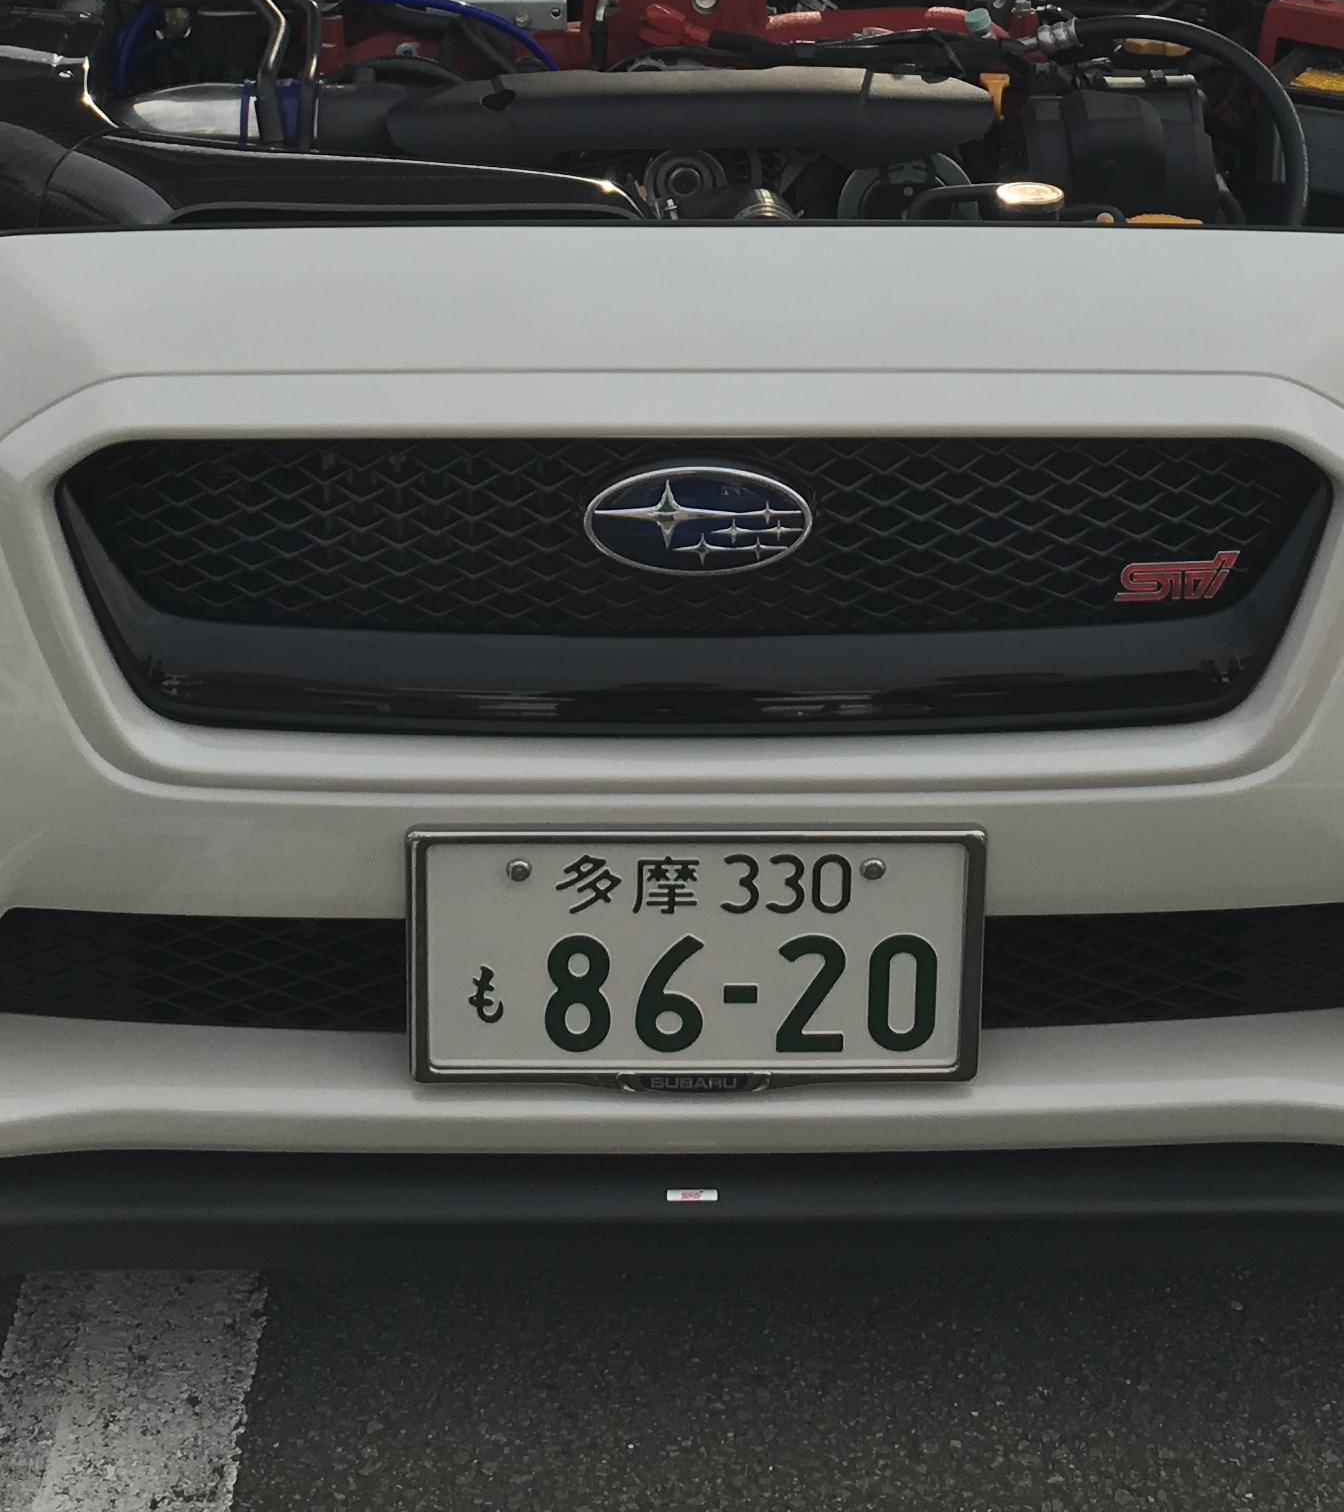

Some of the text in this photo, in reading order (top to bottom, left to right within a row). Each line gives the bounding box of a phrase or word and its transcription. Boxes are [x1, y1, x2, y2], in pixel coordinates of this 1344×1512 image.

[555, 853, 853, 915] 多摩 330
[467, 934, 938, 1053] も 86-20
[650, 1077, 737, 1089] SUBARU
